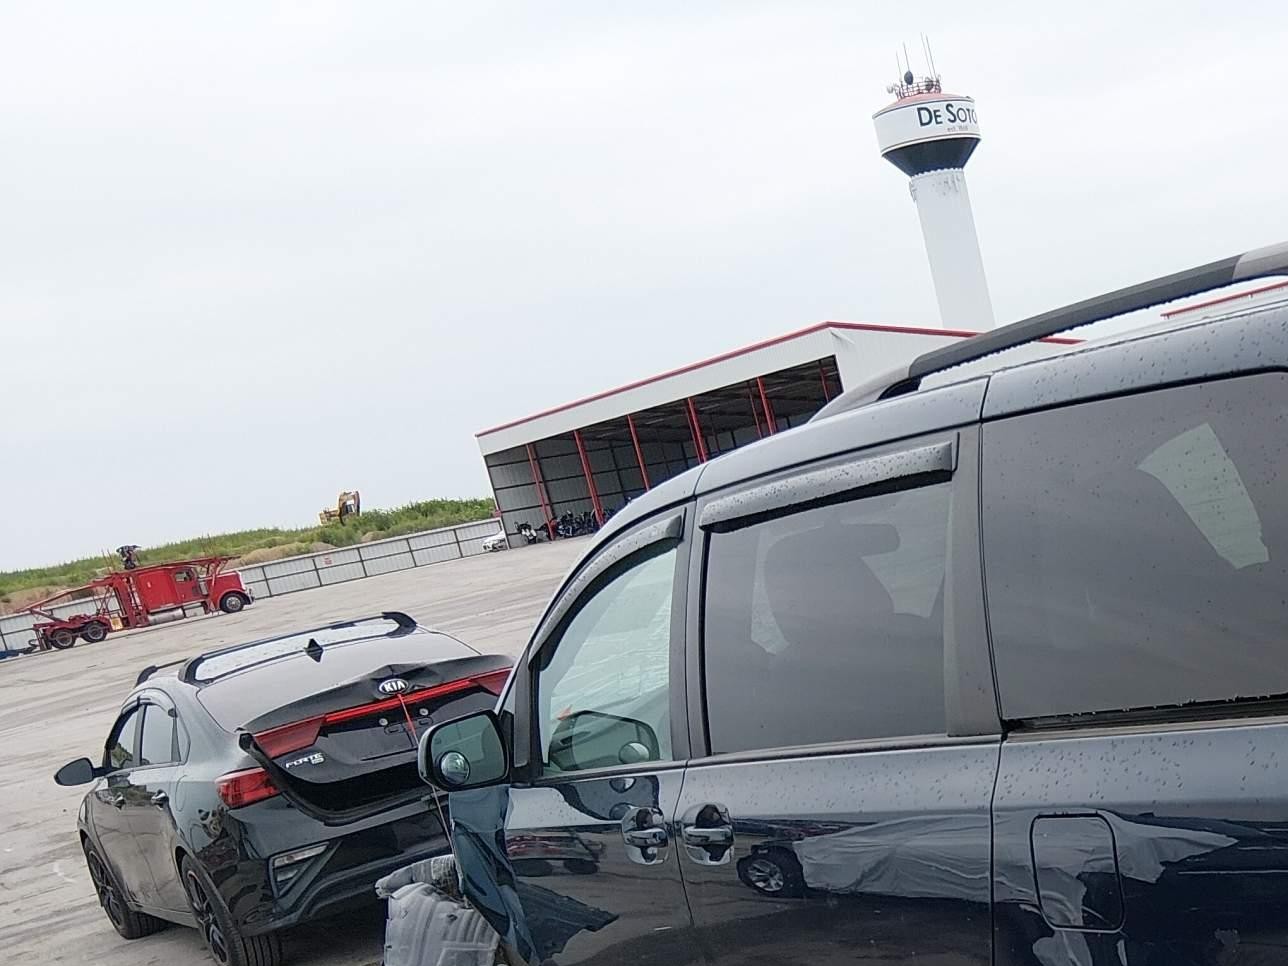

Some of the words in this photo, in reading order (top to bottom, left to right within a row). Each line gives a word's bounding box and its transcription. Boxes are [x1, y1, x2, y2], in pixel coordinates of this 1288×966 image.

[917, 107, 943, 127] DE
[383, 680, 406, 692] KIA
[285, 752, 323, 768] FORTE
